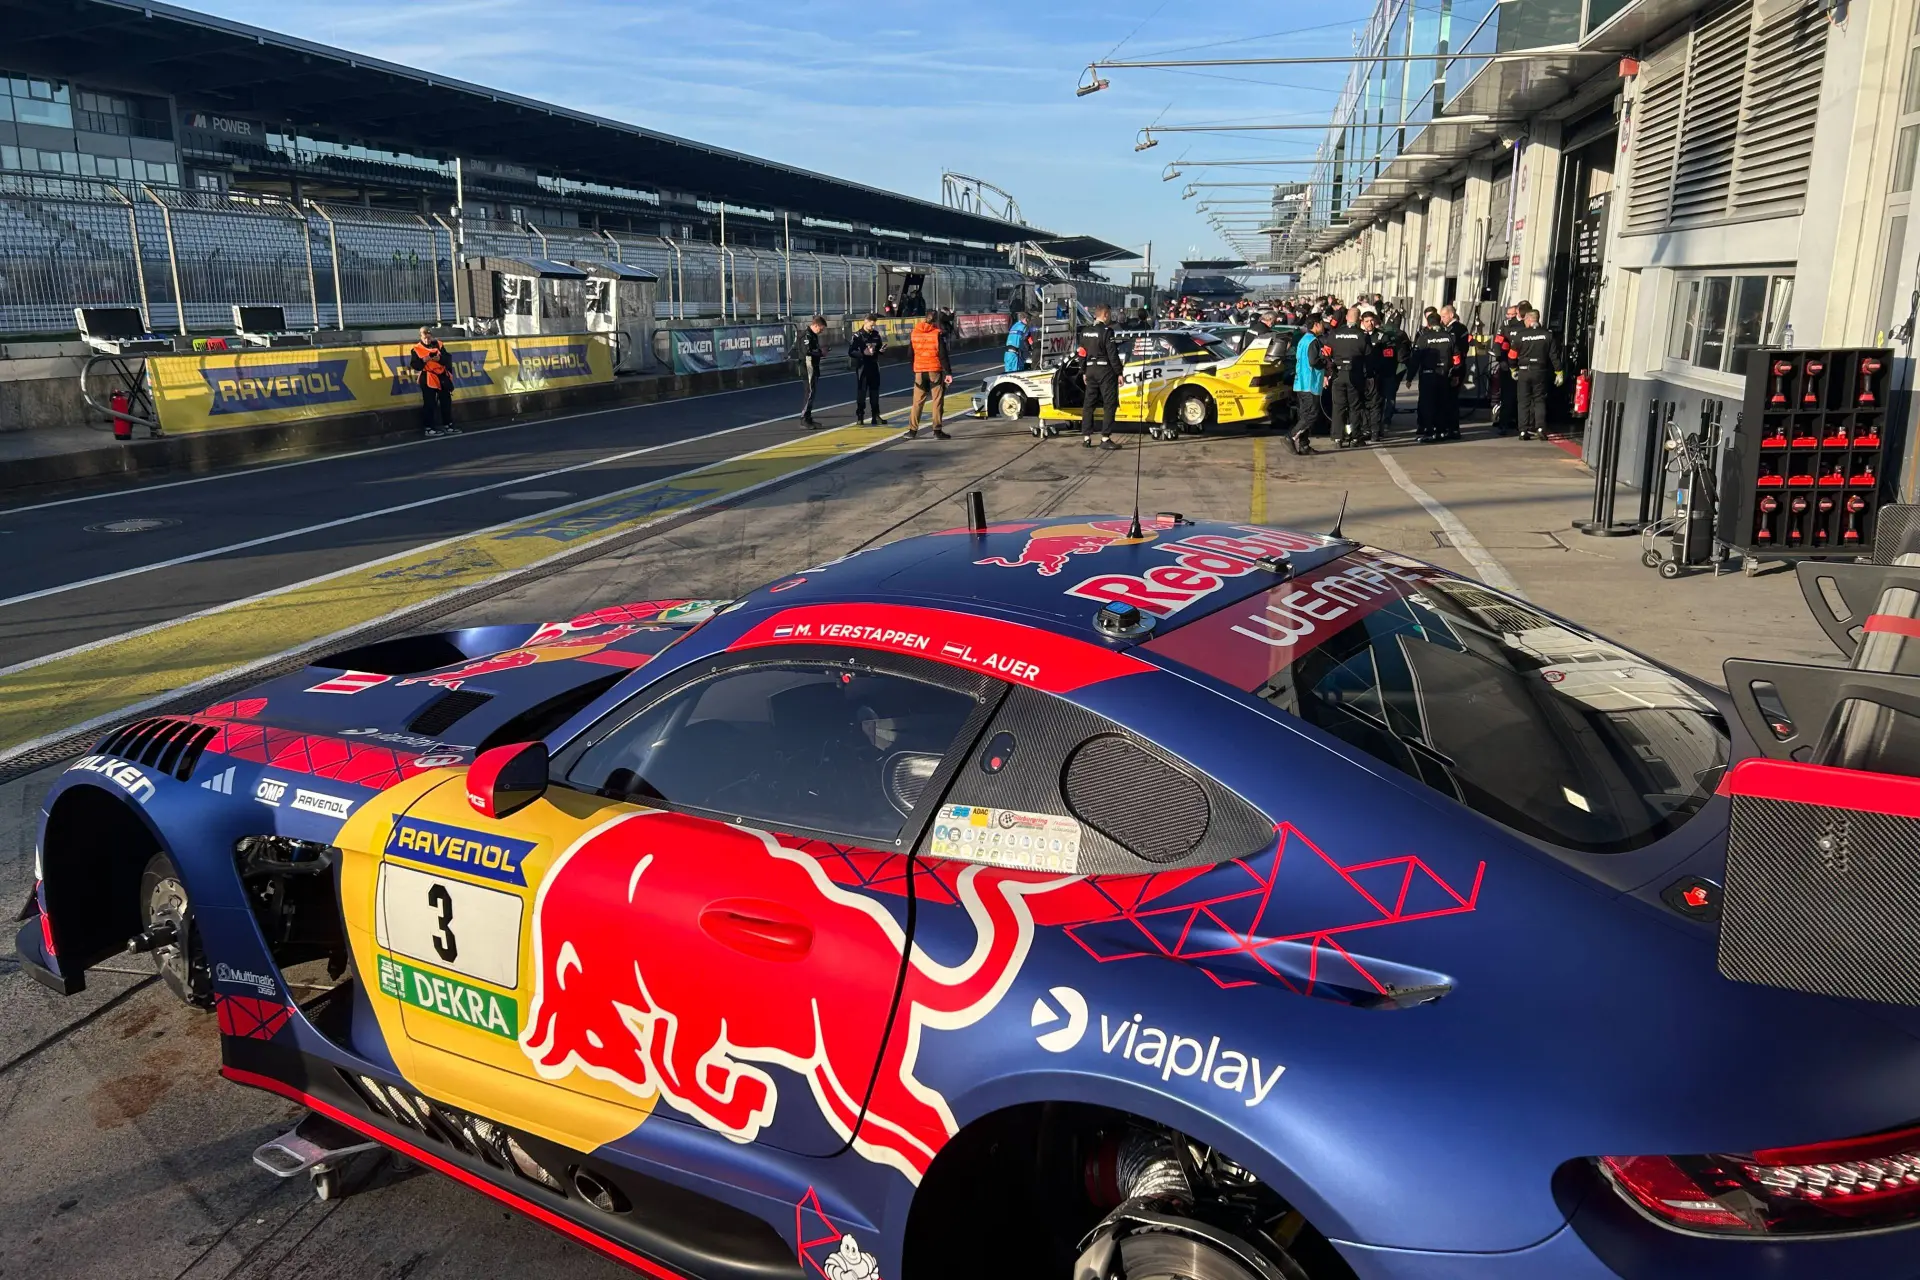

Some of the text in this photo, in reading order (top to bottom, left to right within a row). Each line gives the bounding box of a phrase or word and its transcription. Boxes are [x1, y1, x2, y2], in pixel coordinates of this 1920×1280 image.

[212, 116, 252, 136] POWER
[677, 340, 713, 355] FALKEN
[719, 337, 751, 352] FALKEN
[756, 334, 784, 348] FALKEN
[521, 353, 585, 373] RAVENOL
[217, 372, 341, 402] RAVENOL
[1229, 560, 1424, 648] WEMPE
[794, 623, 931, 651] M. VERSTAPPEN
[961, 645, 1041, 682] L. AUER
[257, 782, 285, 802] OMP
[465, 790, 486, 808] MG
[297, 794, 345, 814] RAVENOL
[973, 807, 989, 816] ADAC
[398, 826, 516, 874] RAVENOL
[428, 883, 458, 964] 3
[230, 968, 275, 987] Multimatic
[413, 971, 511, 1036] DEKRA
[1101, 1013, 1287, 1107] viaplay
